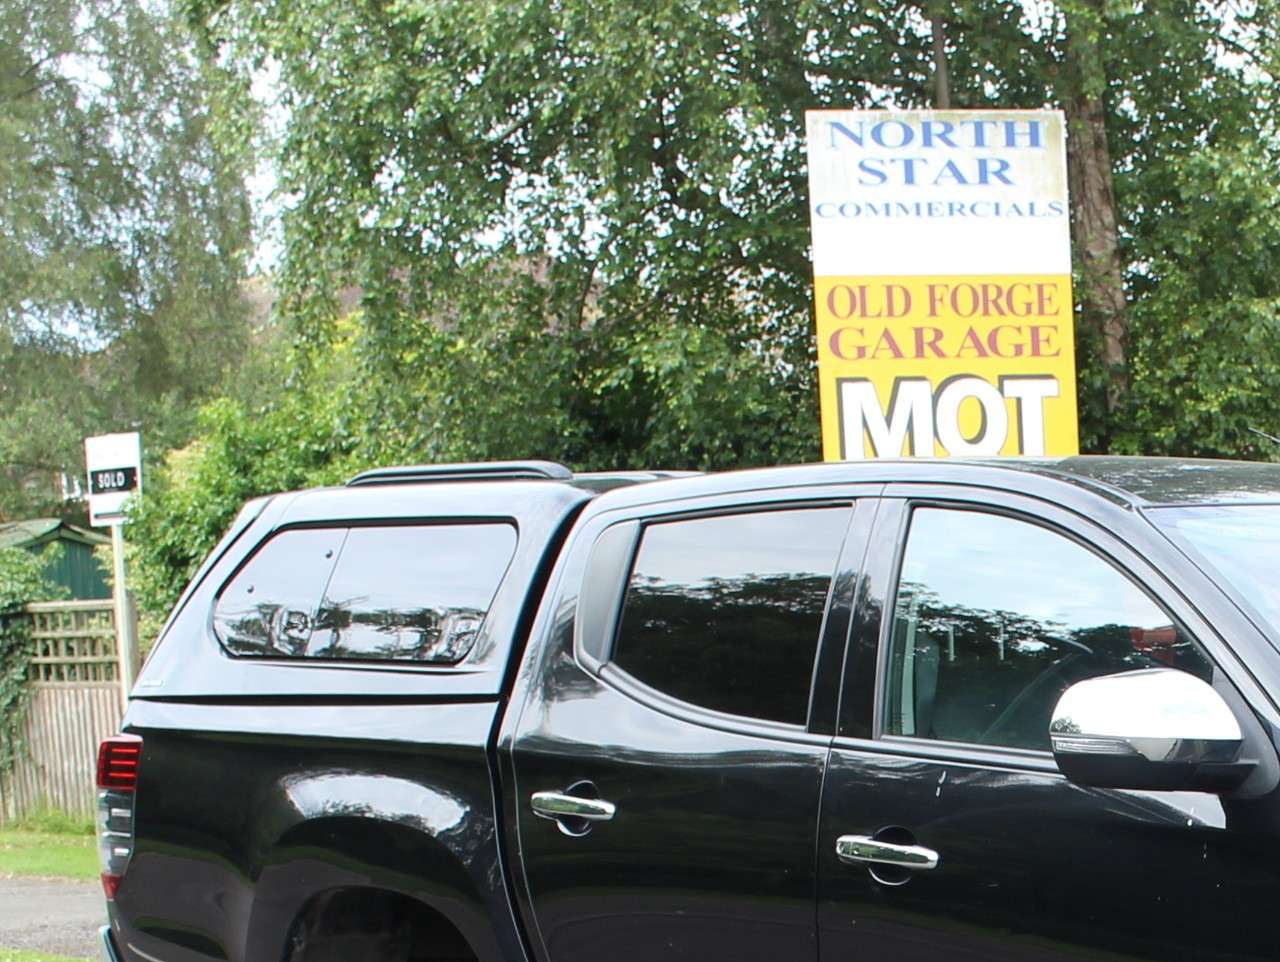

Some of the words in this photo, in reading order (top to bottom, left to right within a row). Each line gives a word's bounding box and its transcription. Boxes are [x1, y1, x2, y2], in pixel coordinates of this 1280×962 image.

[829, 120, 1044, 149] NORTH
[857, 158, 1017, 186] STAR
[815, 201, 1065, 219] COMMERCIALS
[827, 284, 912, 319] OLD
[927, 282, 1060, 318] FORGE
[828, 325, 1061, 361] GARAGE
[835, 373, 1059, 460] MOT
[98, 472, 124, 488] SOLD
